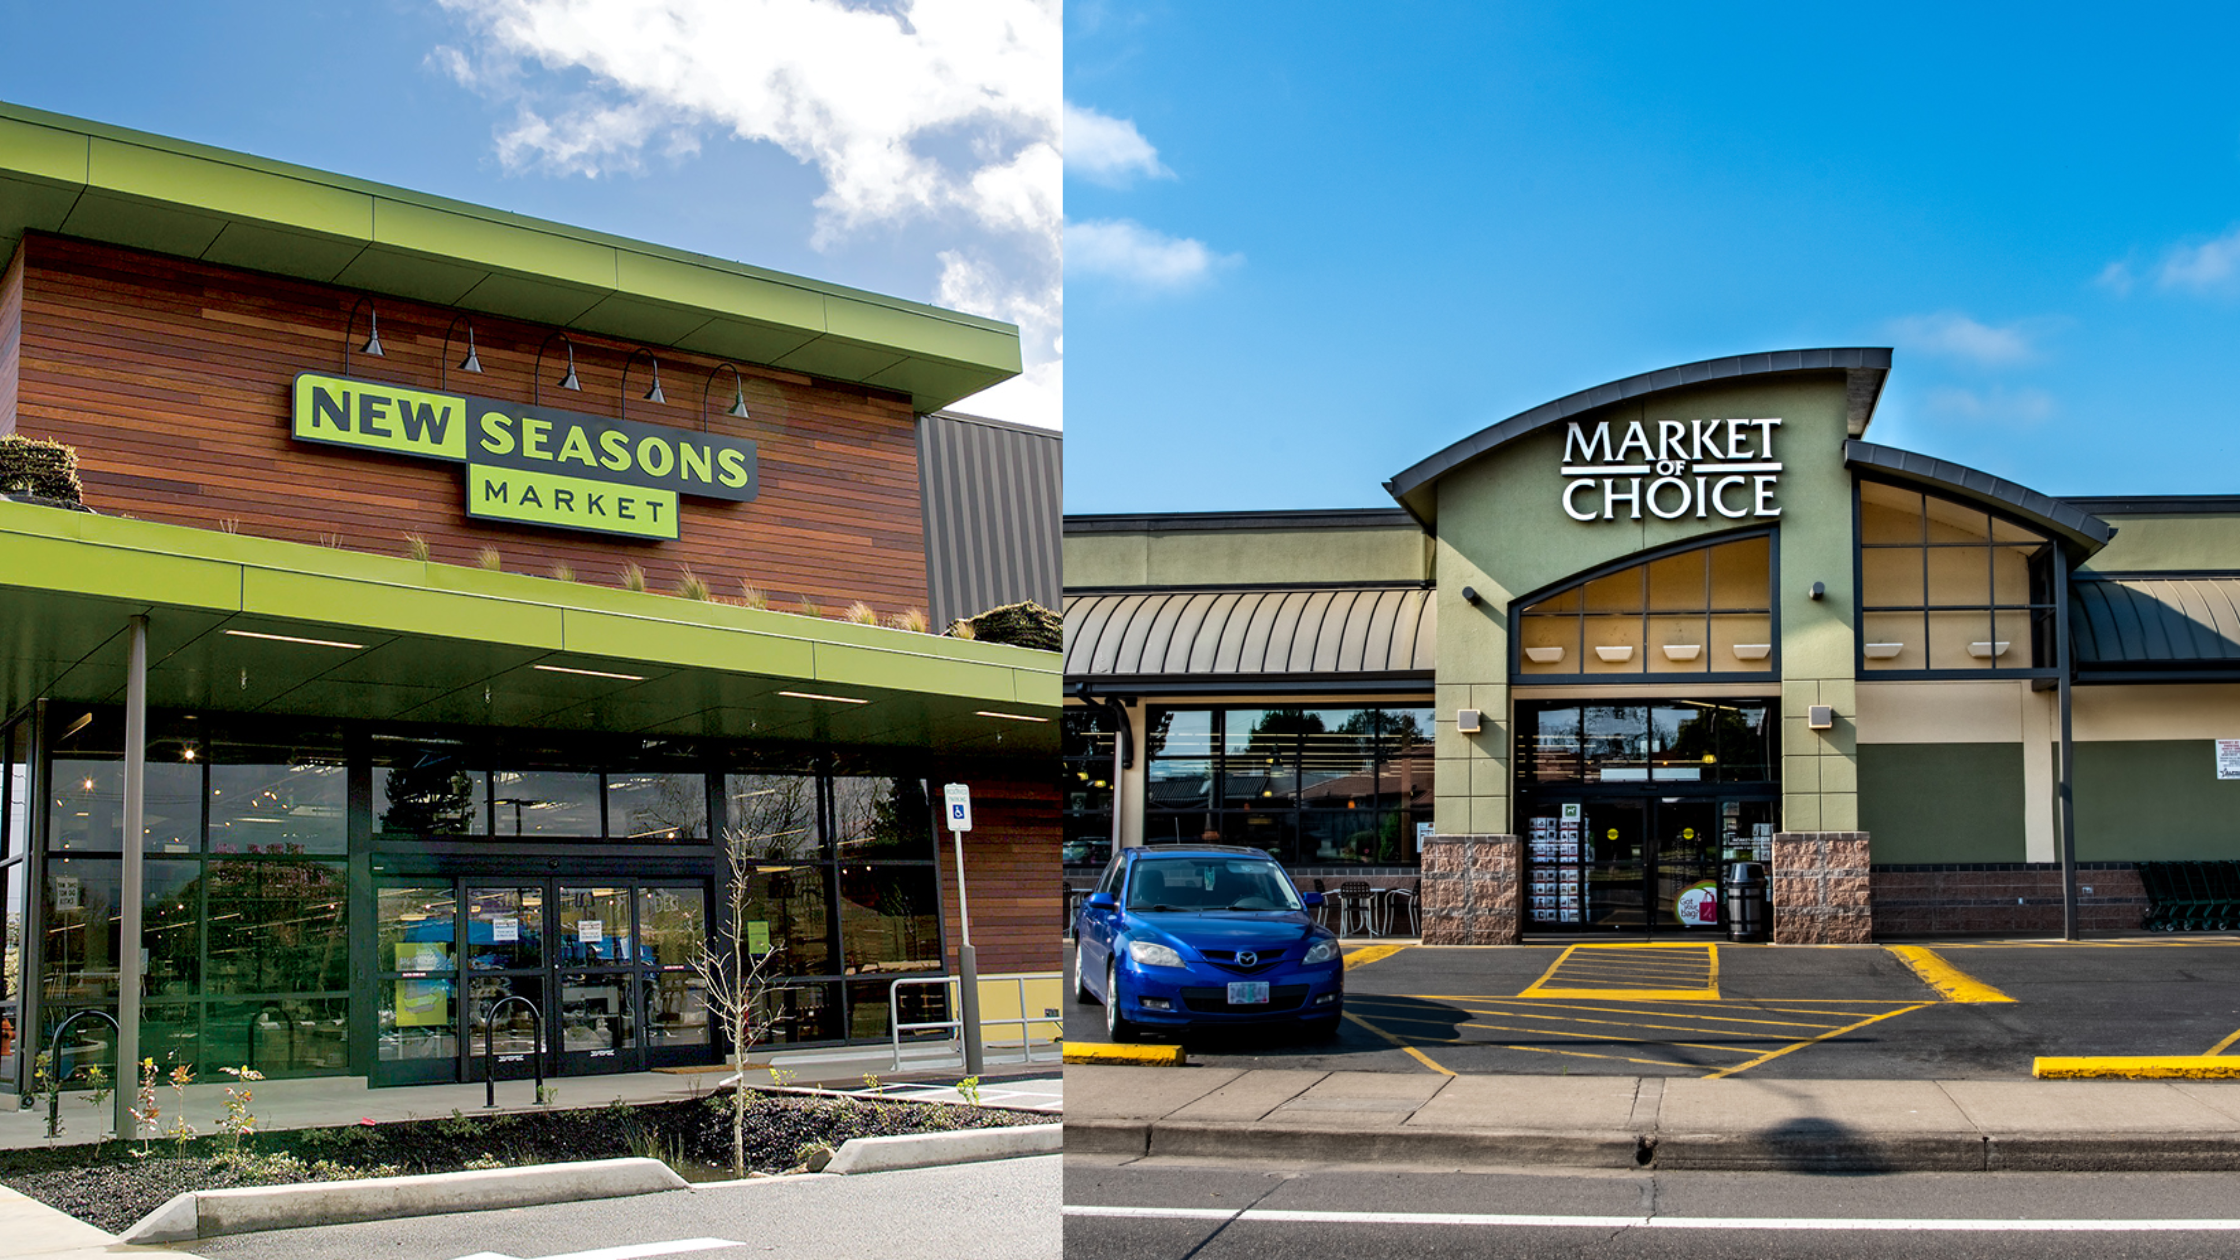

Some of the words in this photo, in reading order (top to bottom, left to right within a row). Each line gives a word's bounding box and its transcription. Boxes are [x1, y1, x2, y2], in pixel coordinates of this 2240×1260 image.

[311, 386, 452, 445] NEW
[479, 411, 749, 489] SEASONS
[1561, 418, 1783, 463] MARKET
[1656, 460, 1687, 477] OF
[484, 481, 665, 523] MARKET
[1561, 475, 1783, 522] CHOICE
[1680, 897, 1693, 905] Got
